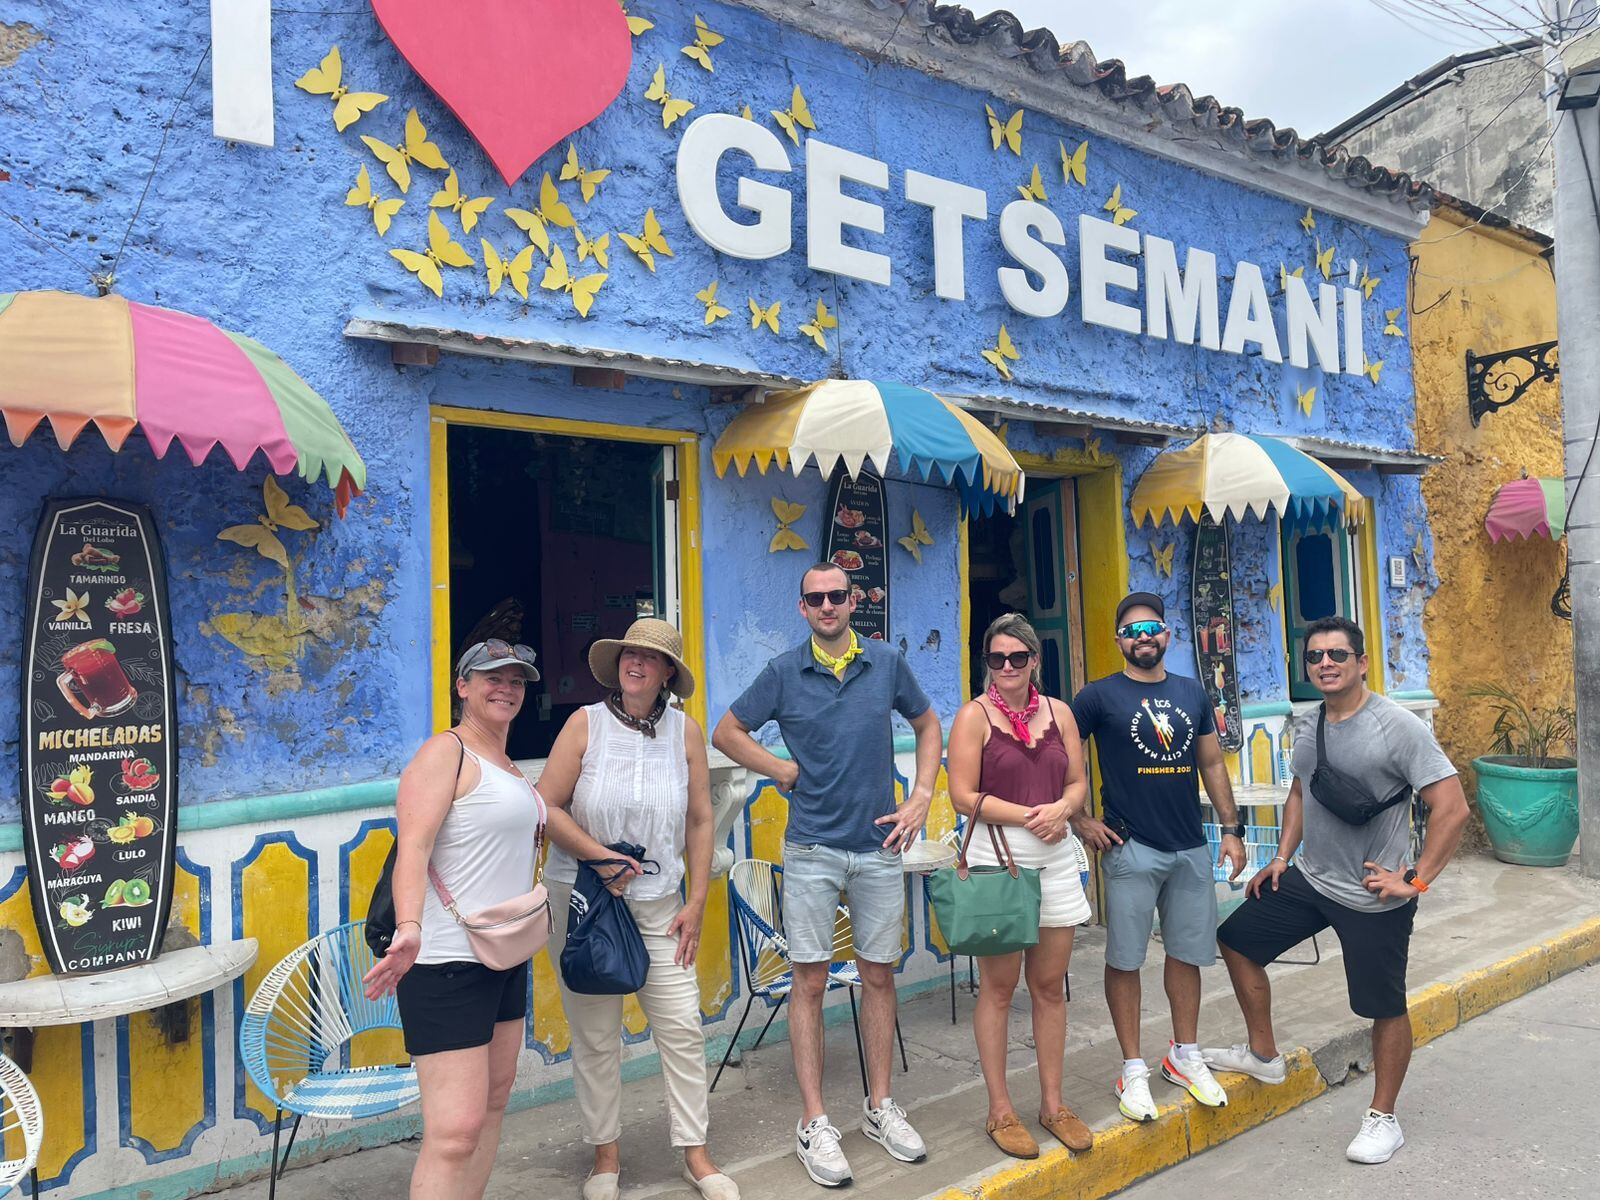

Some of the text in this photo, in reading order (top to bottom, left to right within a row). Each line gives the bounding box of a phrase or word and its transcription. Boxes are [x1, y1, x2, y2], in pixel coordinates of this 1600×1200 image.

[676, 113, 1365, 377] GETSEMANÍ
[59, 524, 137, 538] La Guarida
[70, 575, 127, 585] TAMARINDO
[48, 622, 93, 632] VAINILLA
[109, 622, 152, 635] FRESA
[1153, 698, 1172, 709] tcs
[38, 724, 163, 751] MICHELADAS
[1130, 707, 1195, 762] NEW YORK CITY MARATHON
[69, 750, 135, 763] MANDARINA
[1137, 767, 1175, 775] FINISHER
[115, 794, 156, 805] SANDIA
[44, 809, 96, 826] MANGO
[118, 849, 147, 862] LULO
[47, 873, 103, 890] MARACUYA
[112, 916, 142, 933] KIWI
[68, 948, 148, 971] COMPANY
